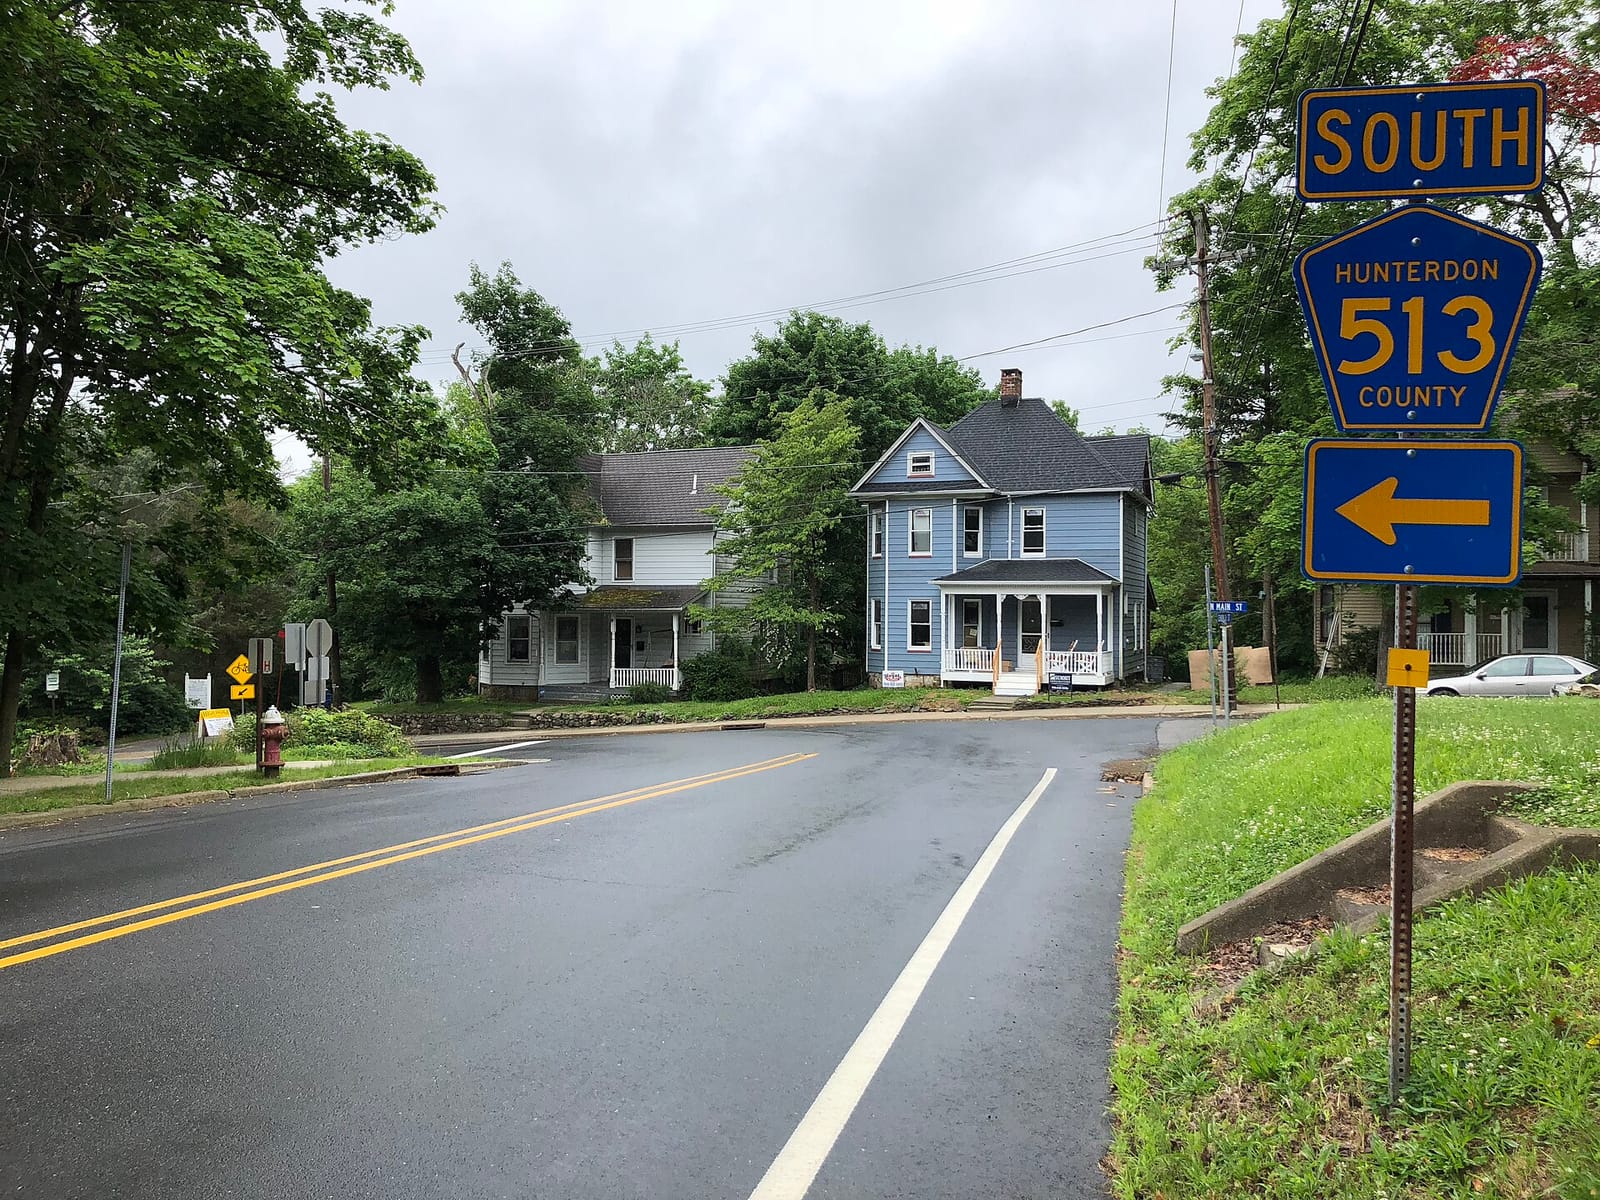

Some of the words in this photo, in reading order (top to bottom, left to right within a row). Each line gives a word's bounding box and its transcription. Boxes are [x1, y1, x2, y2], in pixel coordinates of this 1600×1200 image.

[1313, 106, 1529, 175] SOUTH
[1335, 259, 1499, 284] HUNTERDON
[1337, 295, 1496, 375] 513
[1359, 385, 1467, 408] COUNTY
[1210, 602, 1215, 611] N
[1216, 602, 1231, 611] MAIN
[1235, 602, 1243, 611] ST
